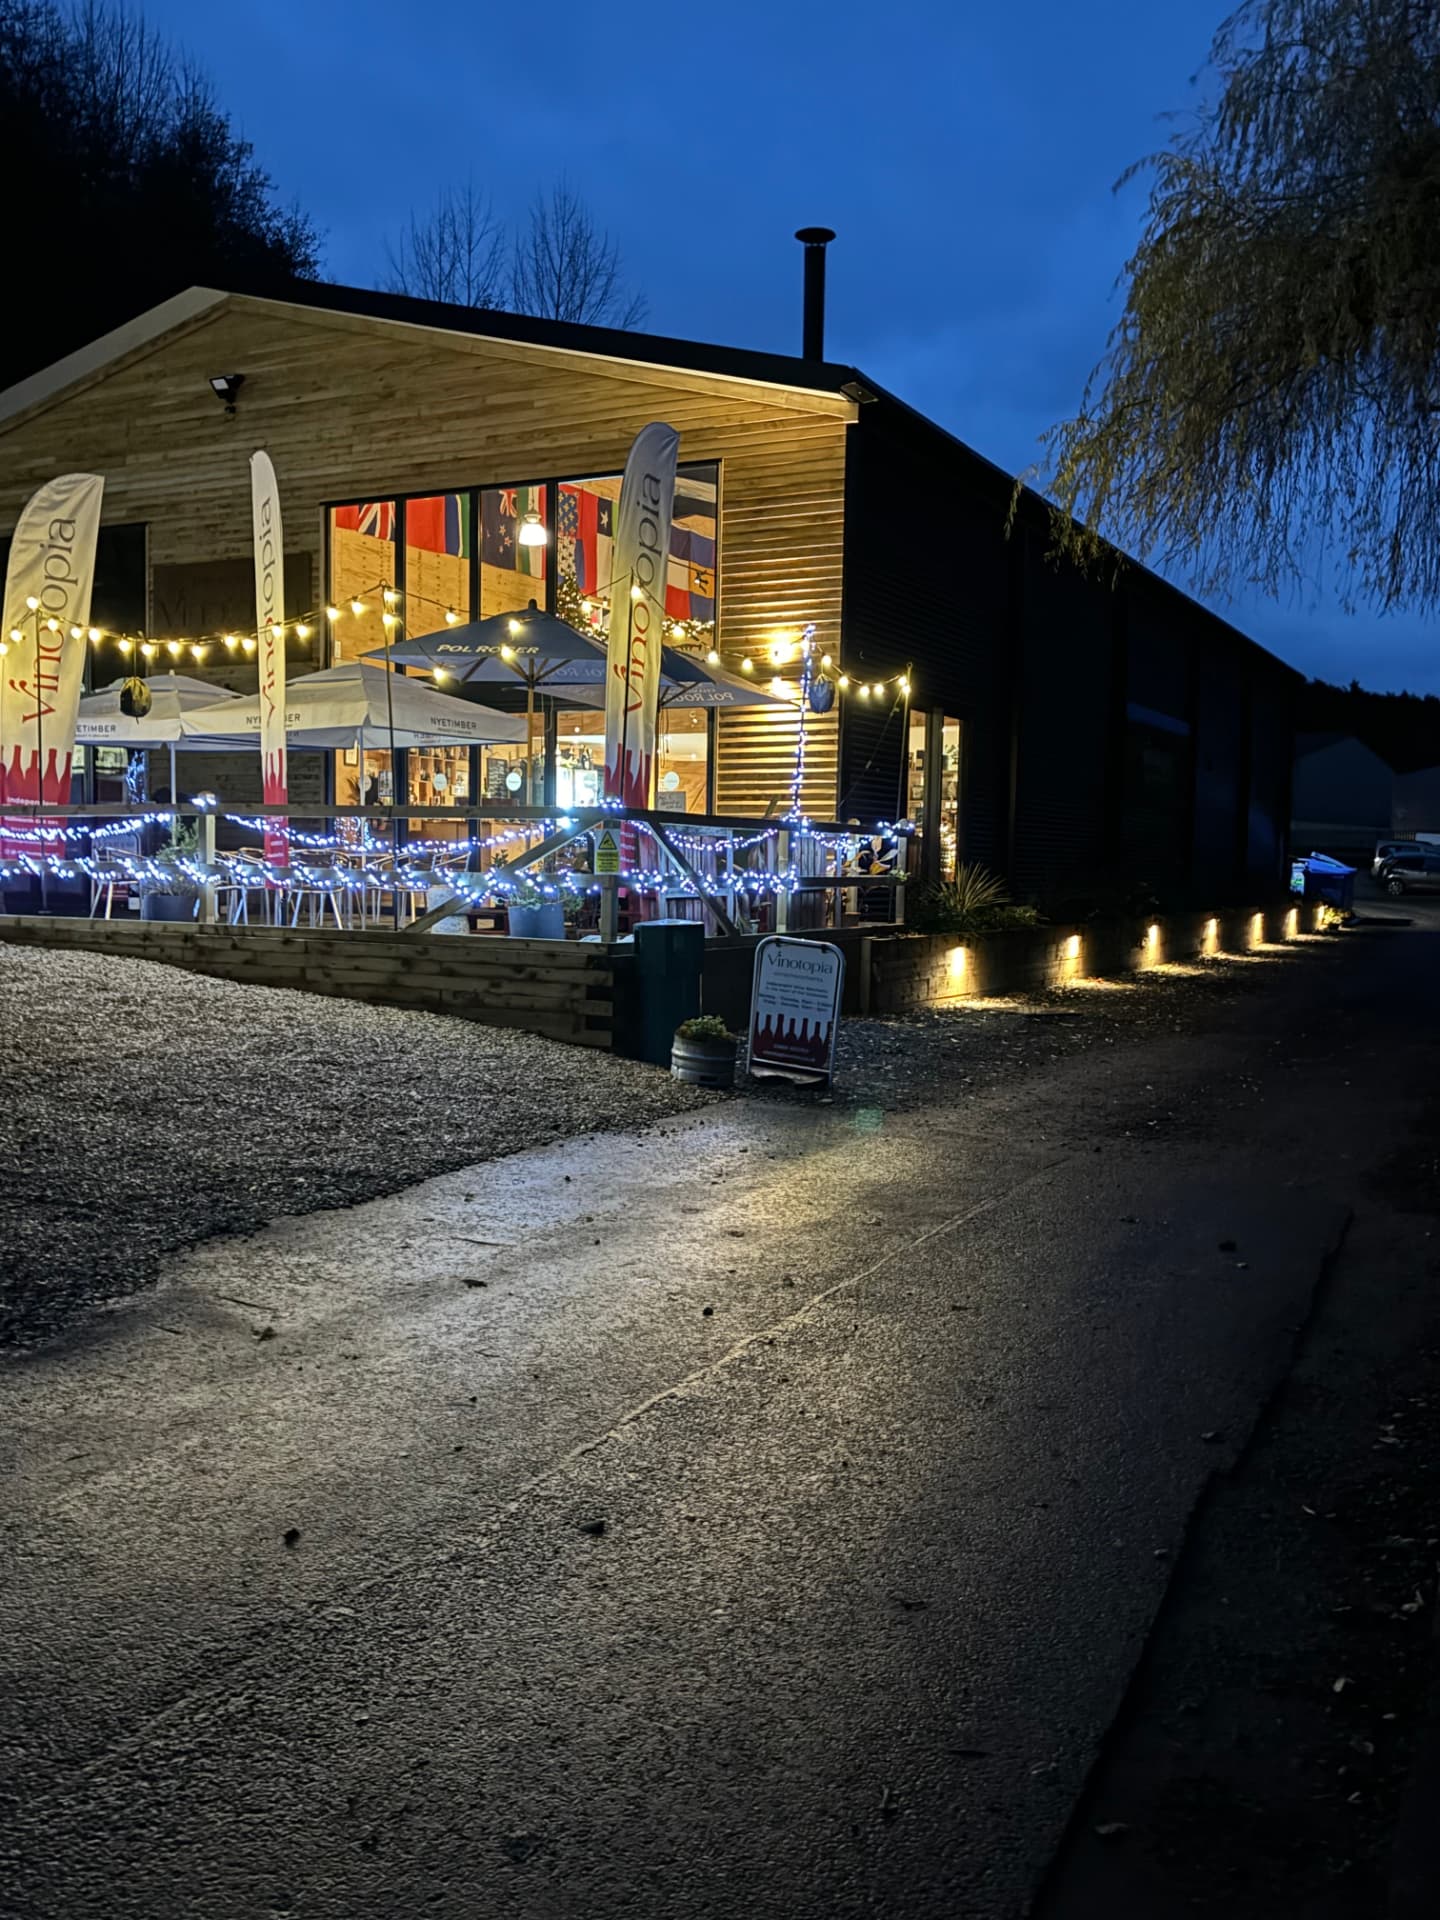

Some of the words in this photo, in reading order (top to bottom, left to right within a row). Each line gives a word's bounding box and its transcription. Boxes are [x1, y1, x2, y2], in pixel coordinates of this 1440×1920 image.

[613, 473, 662, 715] Vinoopia
[9, 517, 78, 724] Vinoopia
[436, 644, 472, 653] POL
[475, 645, 540, 654] ROER
[76, 724, 117, 733] ETIMBER
[430, 716, 477, 730] NYETIMBER
[767, 951, 833, 974] Vinotopia
